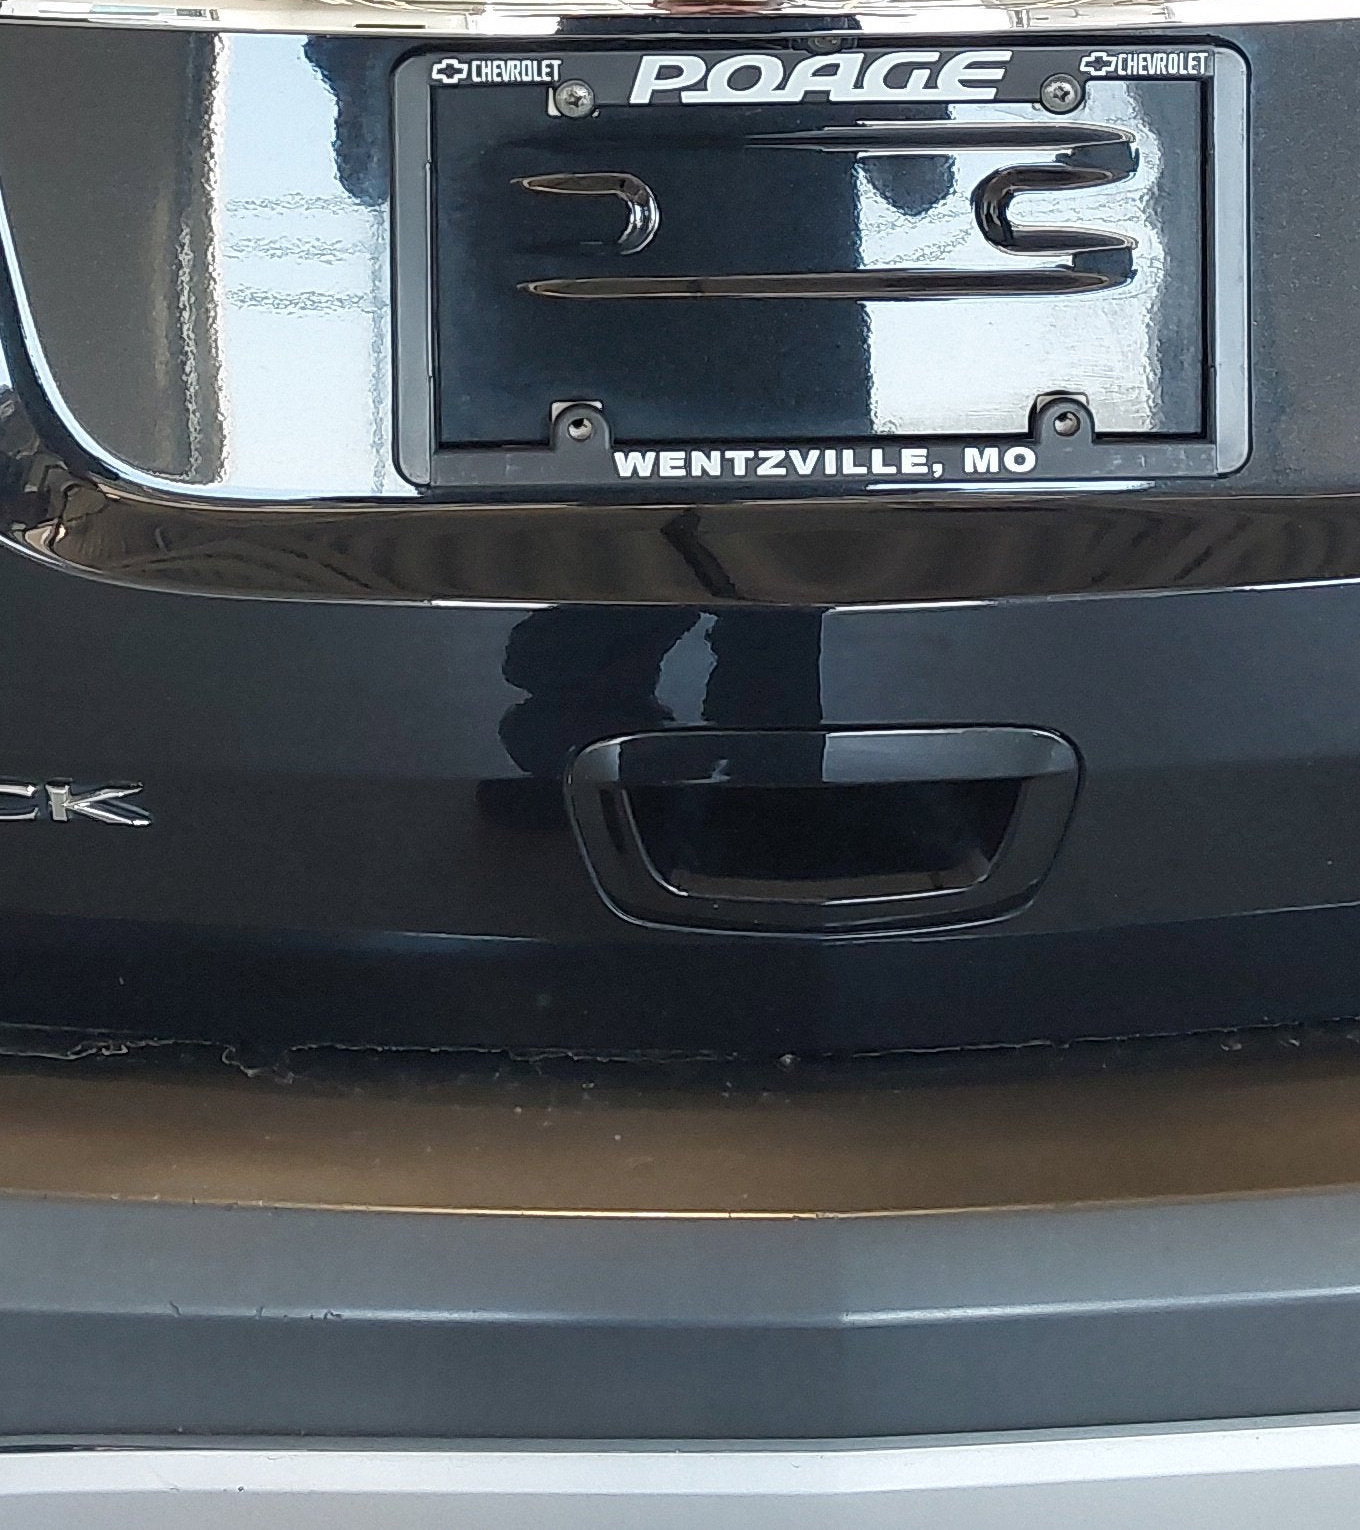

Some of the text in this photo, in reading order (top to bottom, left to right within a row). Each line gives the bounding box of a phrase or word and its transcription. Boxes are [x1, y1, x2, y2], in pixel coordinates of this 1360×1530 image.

[471, 59, 561, 83] CHEVROLET
[629, 51, 1011, 104] POAGE
[1117, 52, 1209, 76] CHEVROLET
[613, 447, 1036, 479] WENTZVILLE, MO
